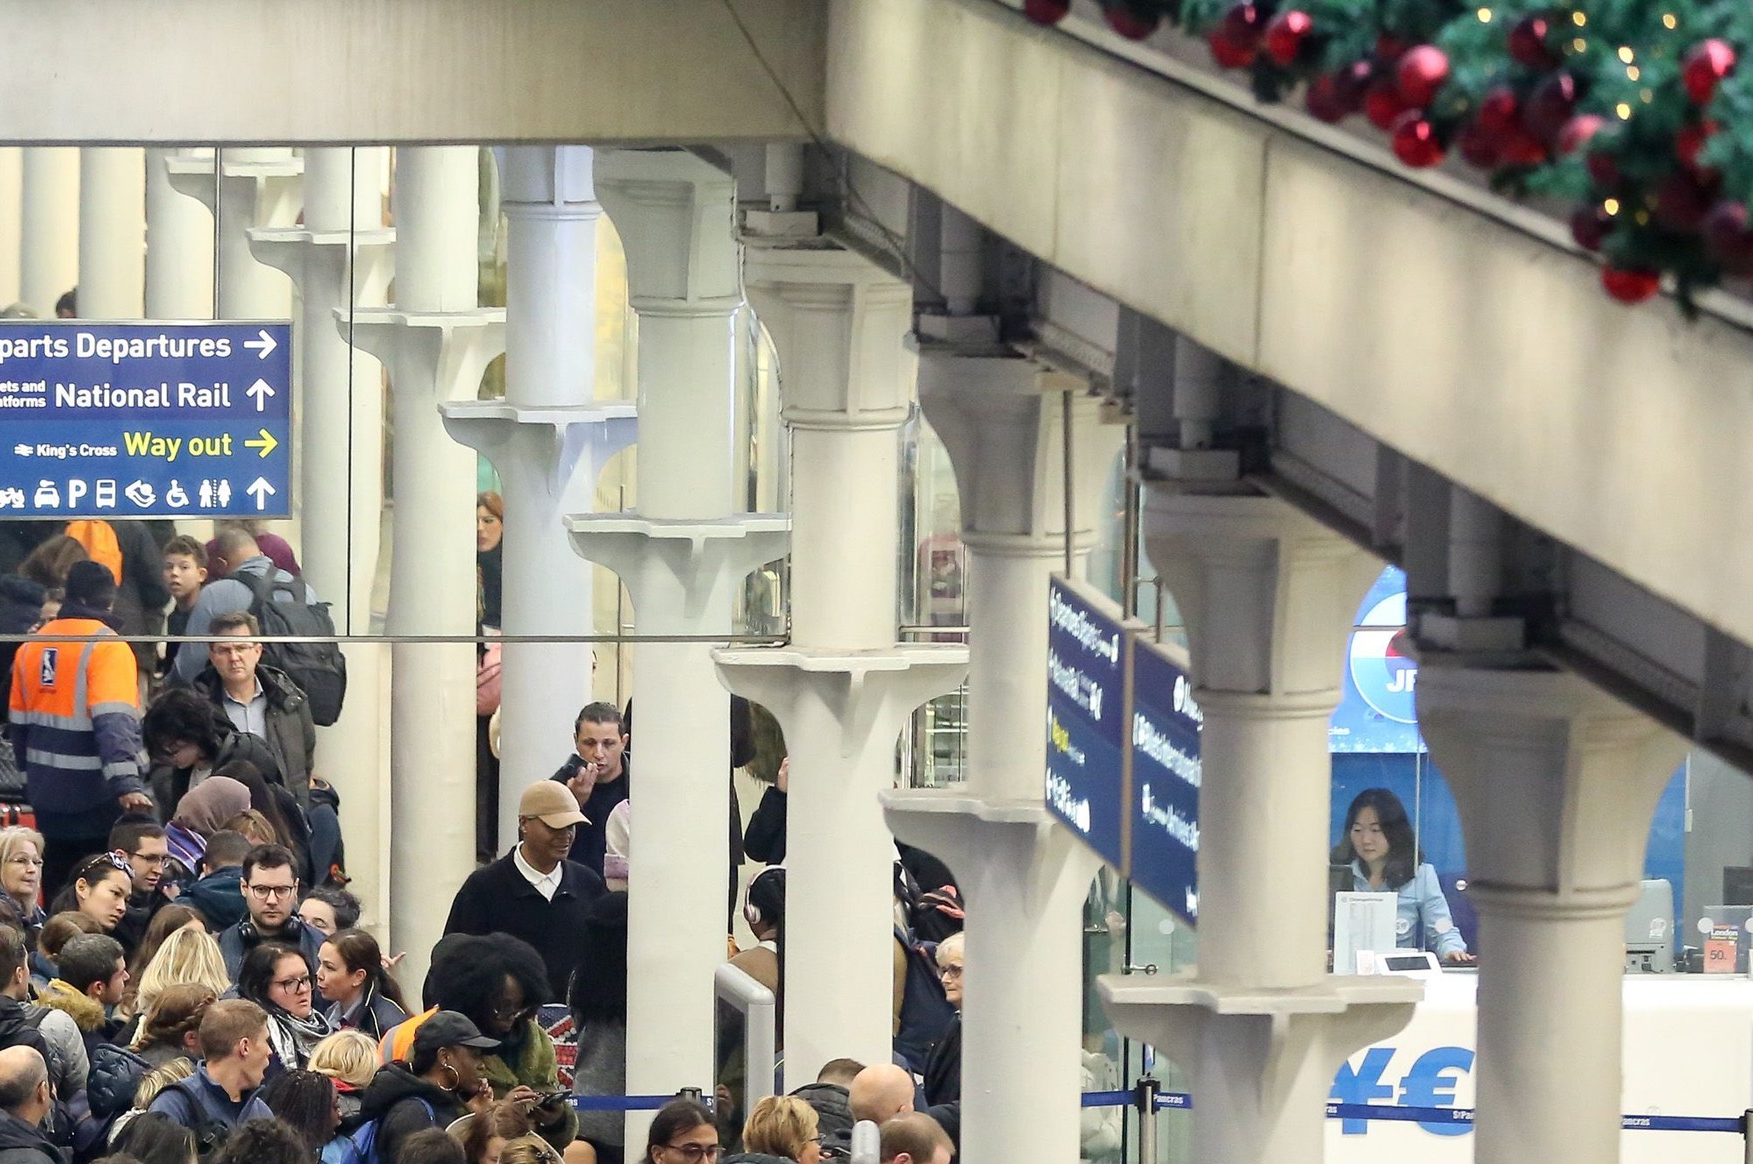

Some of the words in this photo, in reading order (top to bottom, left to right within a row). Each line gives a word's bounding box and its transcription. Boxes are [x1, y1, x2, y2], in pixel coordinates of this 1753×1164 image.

[76, 332, 231, 364] Departures
[21, 379, 46, 393] and
[55, 382, 171, 408] National
[178, 382, 231, 407] Rail
[36, 443, 77, 460] King's
[80, 443, 118, 457] Cross
[123, 431, 182, 462] Way
[188, 433, 232, 456] out
